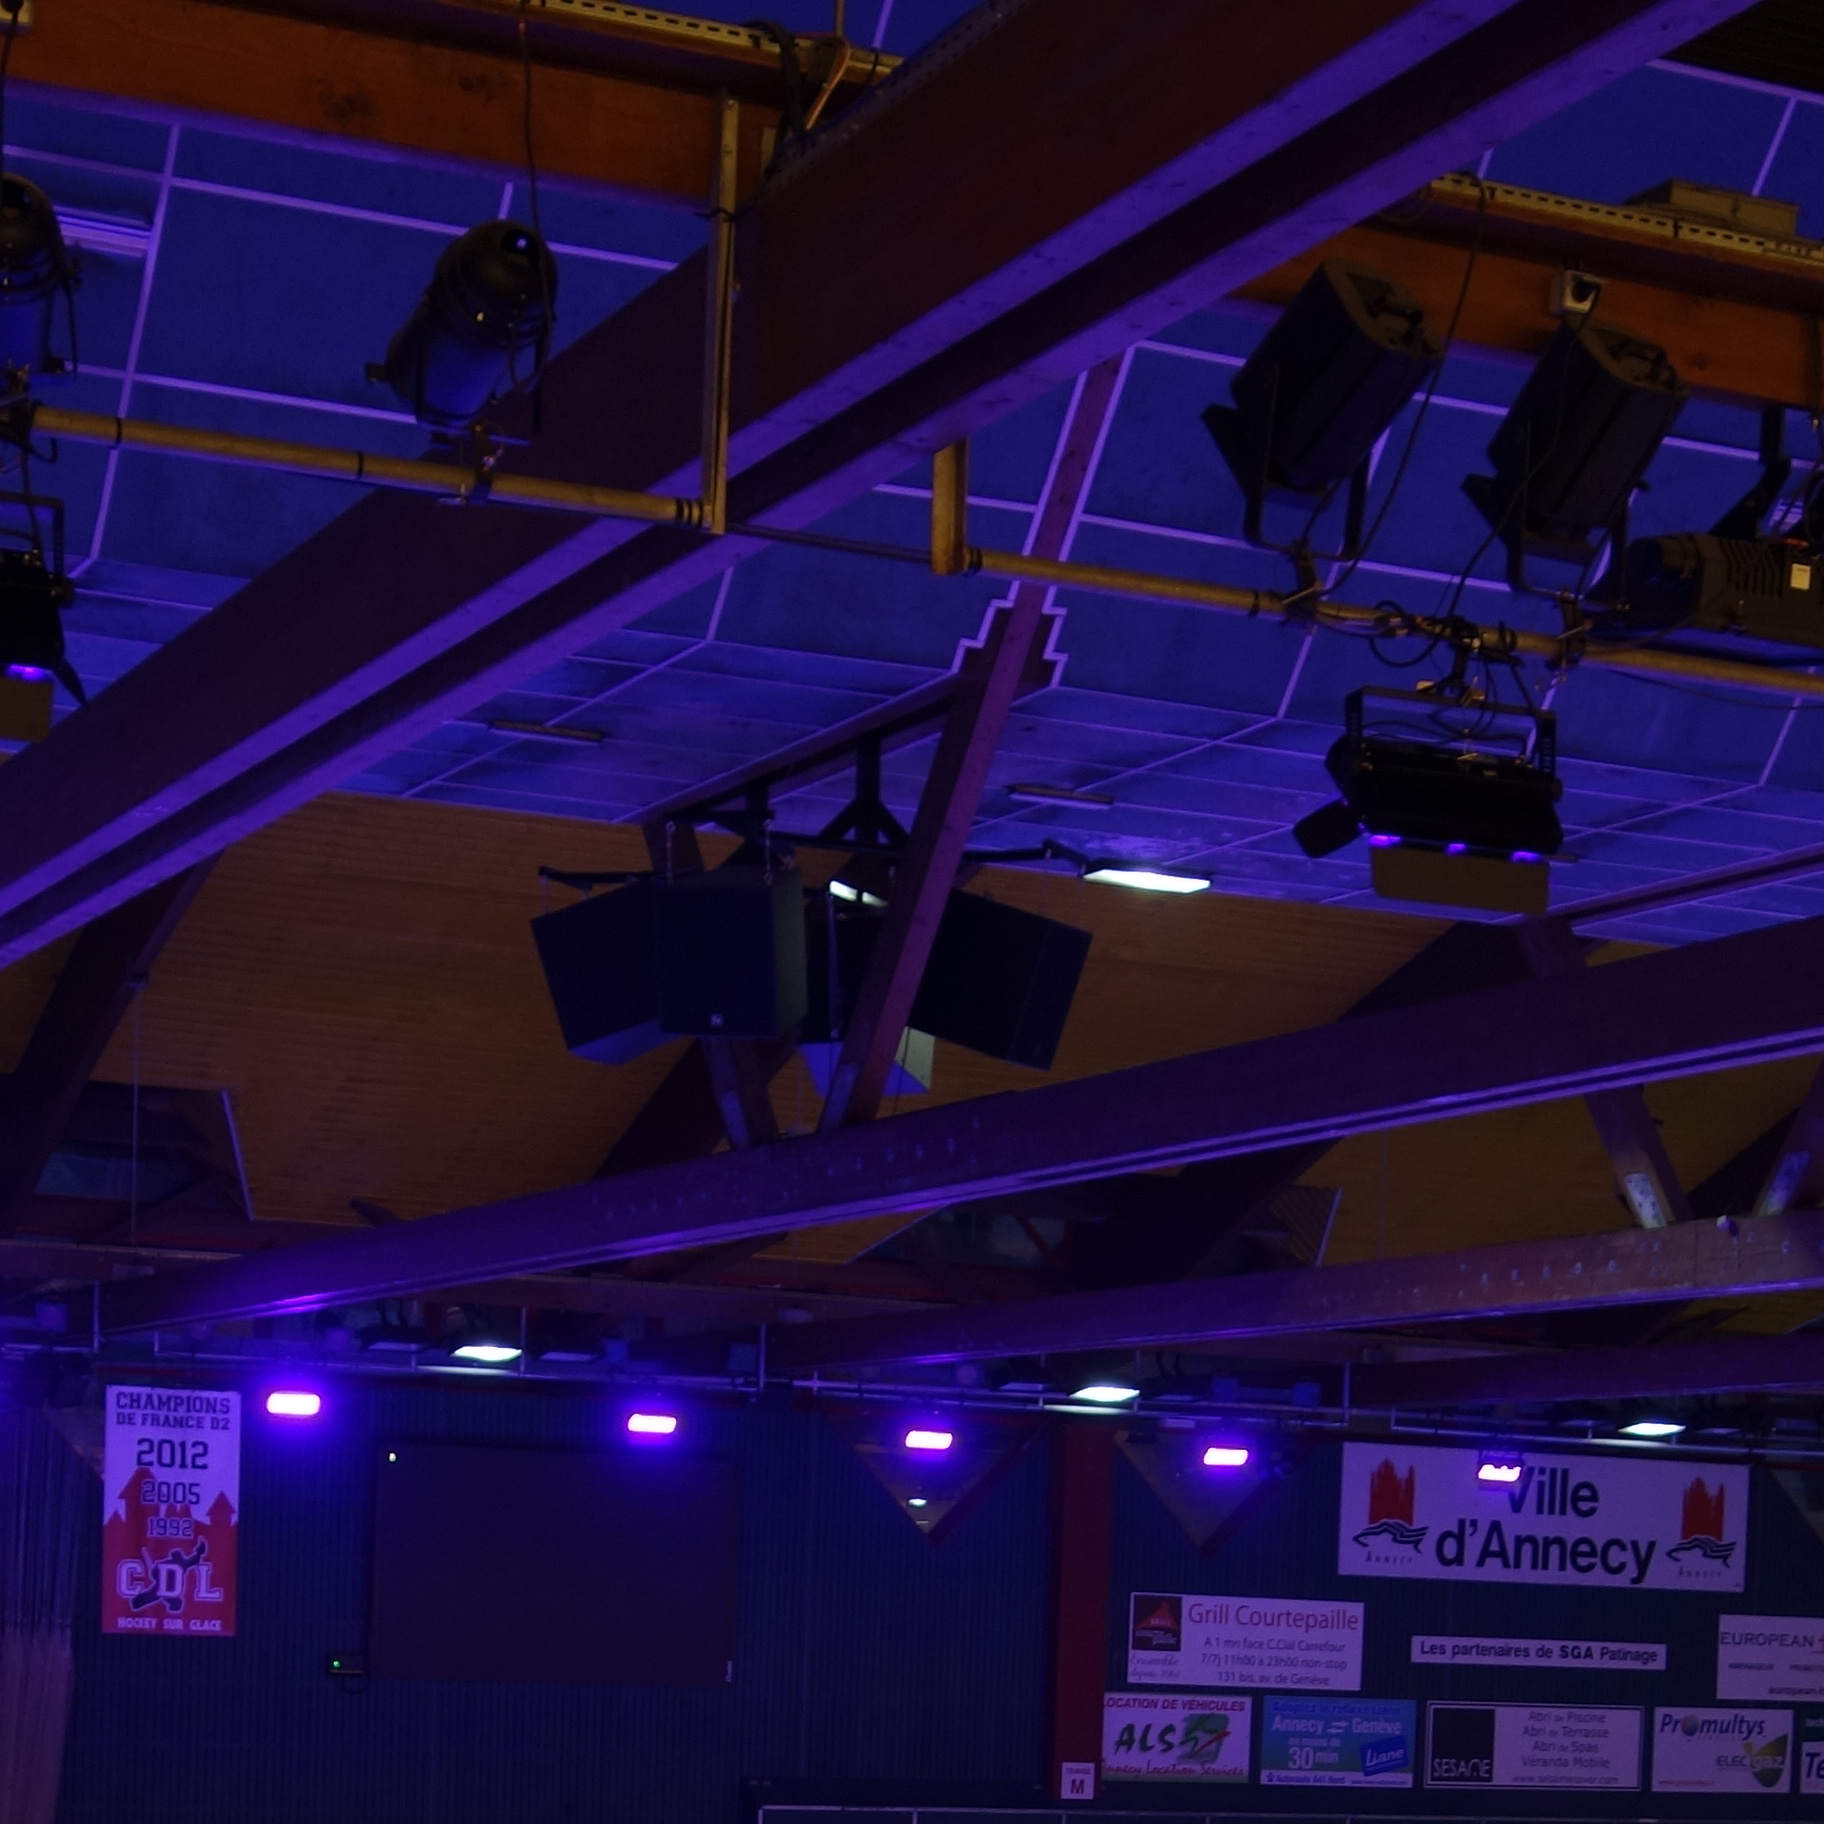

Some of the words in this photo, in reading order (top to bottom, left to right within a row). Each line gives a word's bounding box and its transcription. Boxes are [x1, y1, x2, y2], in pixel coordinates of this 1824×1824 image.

[116, 1392, 231, 1414] CHAMPIONS
[116, 1412, 136, 1426] DE
[141, 1413, 205, 1429] FRANCE
[210, 1417, 230, 1430] D2
[136, 1438, 209, 1470] 2012
[142, 1481, 201, 1505] 2005
[1508, 1467, 1600, 1518] Ville
[148, 1518, 193, 1537] 1992
[1436, 1518, 1656, 1584] d'Annecy
[116, 1559, 223, 1602] CDL
[117, 1617, 157, 1629] HOCKEY
[163, 1618, 183, 1630] SUR
[189, 1619, 222, 1631] GLACE
[1188, 1603, 1230, 1625] Grill
[1236, 1605, 1359, 1633] Courtepaille
[1243, 1637, 1264, 1649] face
[1298, 1640, 1346, 1652] Carrefour
[1720, 1632, 1814, 1648] EUROPEAN
[1224, 1655, 1256, 1666] 11h00
[1266, 1655, 1299, 1667] 23h00
[1421, 1641, 1446, 1655] Les
[1451, 1642, 1530, 1659] partenaires
[1535, 1645, 1553, 1658] de
[1559, 1645, 1594, 1660] SGA
[1600, 1646, 1658, 1665] Patinage
[1218, 1671, 1236, 1682] 131
[1274, 1673, 1288, 1684] de
[1161, 1699, 1179, 1709] DE
[1272, 1715, 1325, 1735] Annecy
[1352, 1717, 1402, 1734] Genève
[1528, 1711, 1551, 1721] Abri
[1566, 1711, 1606, 1723] Piscine
[1660, 1713, 1765, 1740] Promultys
[1115, 1723, 1176, 1755] ALS
[1522, 1725, 1545, 1736] Abri
[1561, 1726, 1609, 1738] Terrasse
[1533, 1740, 1555, 1751] Abri
[1571, 1741, 1599, 1754] Spas
[1288, 1747, 1314, 1769] 30
[1315, 1749, 1339, 1764] min
[1366, 1748, 1404, 1767] Liane
[1573, 1756, 1610, 1768] Mobile
[1146, 1759, 1196, 1775] Location
[1201, 1760, 1243, 1776] Services
[1070, 1779, 1084, 1794] M
